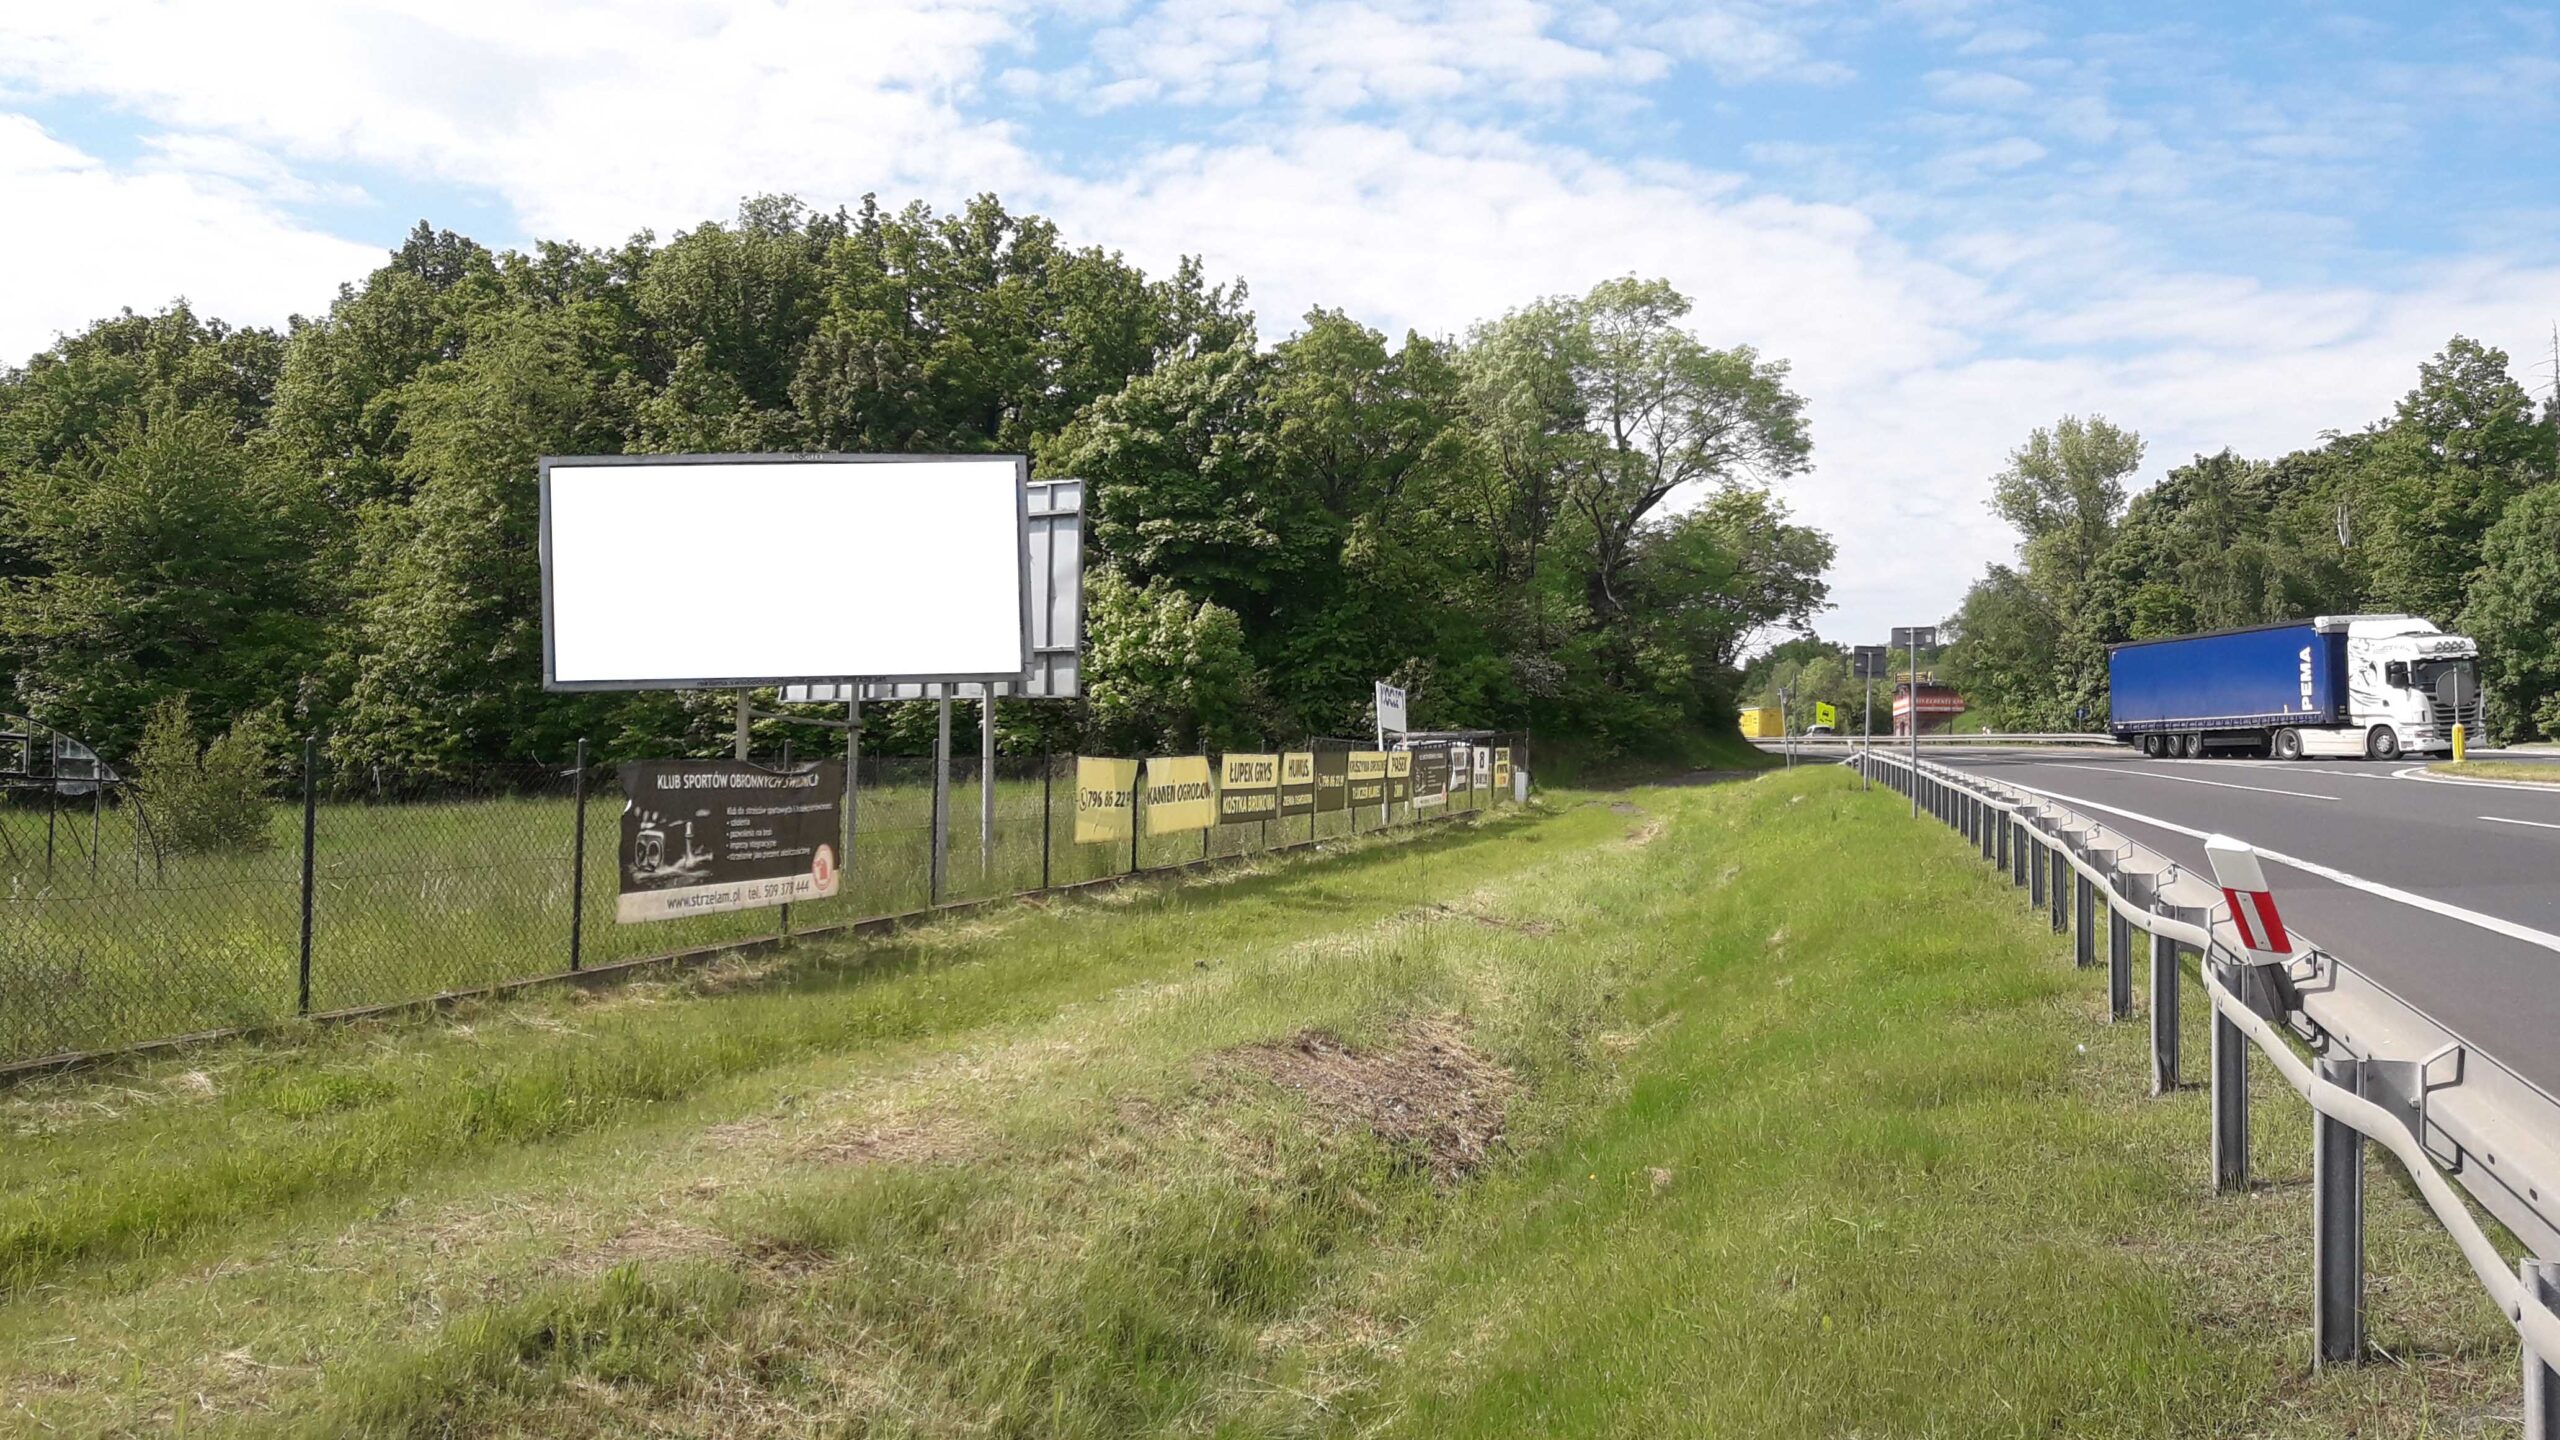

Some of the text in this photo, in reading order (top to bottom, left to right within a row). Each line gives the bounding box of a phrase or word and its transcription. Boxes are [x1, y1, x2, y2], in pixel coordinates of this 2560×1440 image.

[2299, 646, 2312, 711] PEMA
[1229, 762, 1272, 783] ŁUPEK GRYS
[1288, 759, 1309, 777] HUMUS
[657, 774, 682, 790] KLUB
[683, 771, 728, 789] SPORTÓW
[729, 773, 781, 789] OBRONNYCH
[1087, 790, 1103, 808] 796
[1147, 779, 1176, 805] KAMIEŃ
[1222, 796, 1248, 814] KOSTKA
[667, 879, 809, 909] www.strzelam.pl tel. 509 378 444
